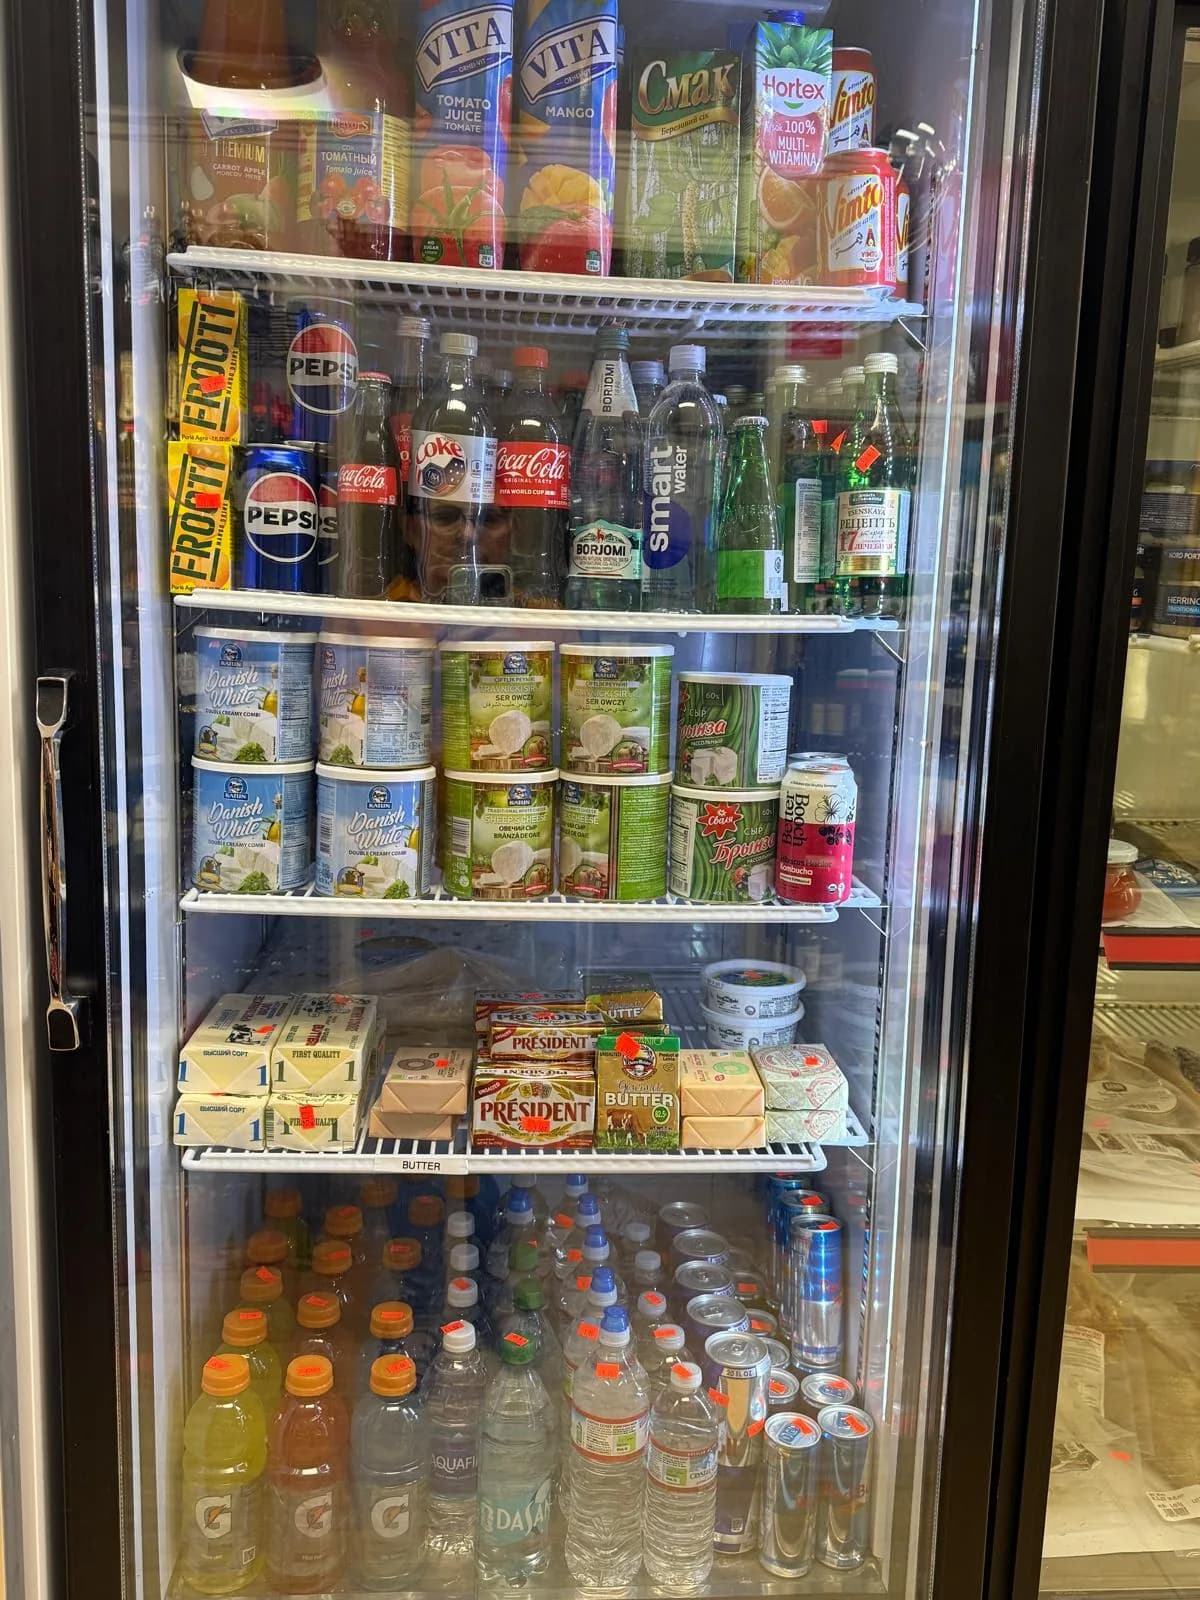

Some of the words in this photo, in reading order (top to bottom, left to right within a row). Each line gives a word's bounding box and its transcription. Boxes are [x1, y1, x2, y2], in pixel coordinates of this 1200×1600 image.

[424, 17, 506, 66] VITA
[527, 28, 610, 79] VITA
[637, 60, 735, 115] Смак
[763, 74, 825, 100] Hortex
[436, 95, 491, 110] TOMATO
[545, 106, 595, 118] MANGO
[829, 77, 875, 129] Vimto
[445, 110, 482, 122] JUICE
[445, 122, 481, 133] TOMATE
[785, 120, 816, 135] 100%
[778, 136, 810, 151] MULTI-
[213, 163, 241, 172] CARROT
[244, 166, 266, 176] APPLE
[321, 151, 377, 165] ТОМАТНЫЙ
[769, 151, 818, 167] WITAMINA
[825, 183, 885, 240] Vimto
[289, 356, 359, 381] PEPSI
[602, 363, 615, 413] BORJOMI
[497, 446, 567, 480] Coca-Cola
[673, 445, 688, 494] water
[338, 465, 386, 490] Coca-Cola
[649, 445, 673, 553] smart
[247, 506, 317, 531] PEPSI
[576, 543, 627, 557] BORJOMI
[840, 531, 859, 552] 17
[204, 664, 260, 695] Danish
[210, 682, 259, 708] White
[208, 796, 264, 824] Danish
[347, 808, 406, 835] Danish
[793, 793, 810, 847] Booch
[213, 817, 263, 841] White
[356, 824, 405, 850] White
[780, 862, 814, 876] Kombucha
[608, 1007, 642, 1019] UTTE
[232, 1050, 249, 1058] СОРТ
[292, 1050, 311, 1059] FIRST
[312, 1050, 342, 1059] QUALITY
[512, 1035, 589, 1051] PRÉSIDENT
[178, 1060, 189, 1083] 1
[256, 1065, 268, 1086] 1
[274, 1060, 287, 1083] 1
[344, 1060, 358, 1082] 1
[478, 1081, 501, 1095] UNSALTED
[605, 1092, 674, 1107] BUTTER
[480, 1098, 592, 1125] PRÉSIDENT
[176, 1112, 188, 1136] 1
[249, 1119, 262, 1142] 1
[327, 1119, 341, 1142] 1
[402, 1160, 441, 1171] BUTTER
[195, 1495, 232, 1540] G
[294, 1492, 333, 1538] G
[370, 1493, 410, 1538] G
